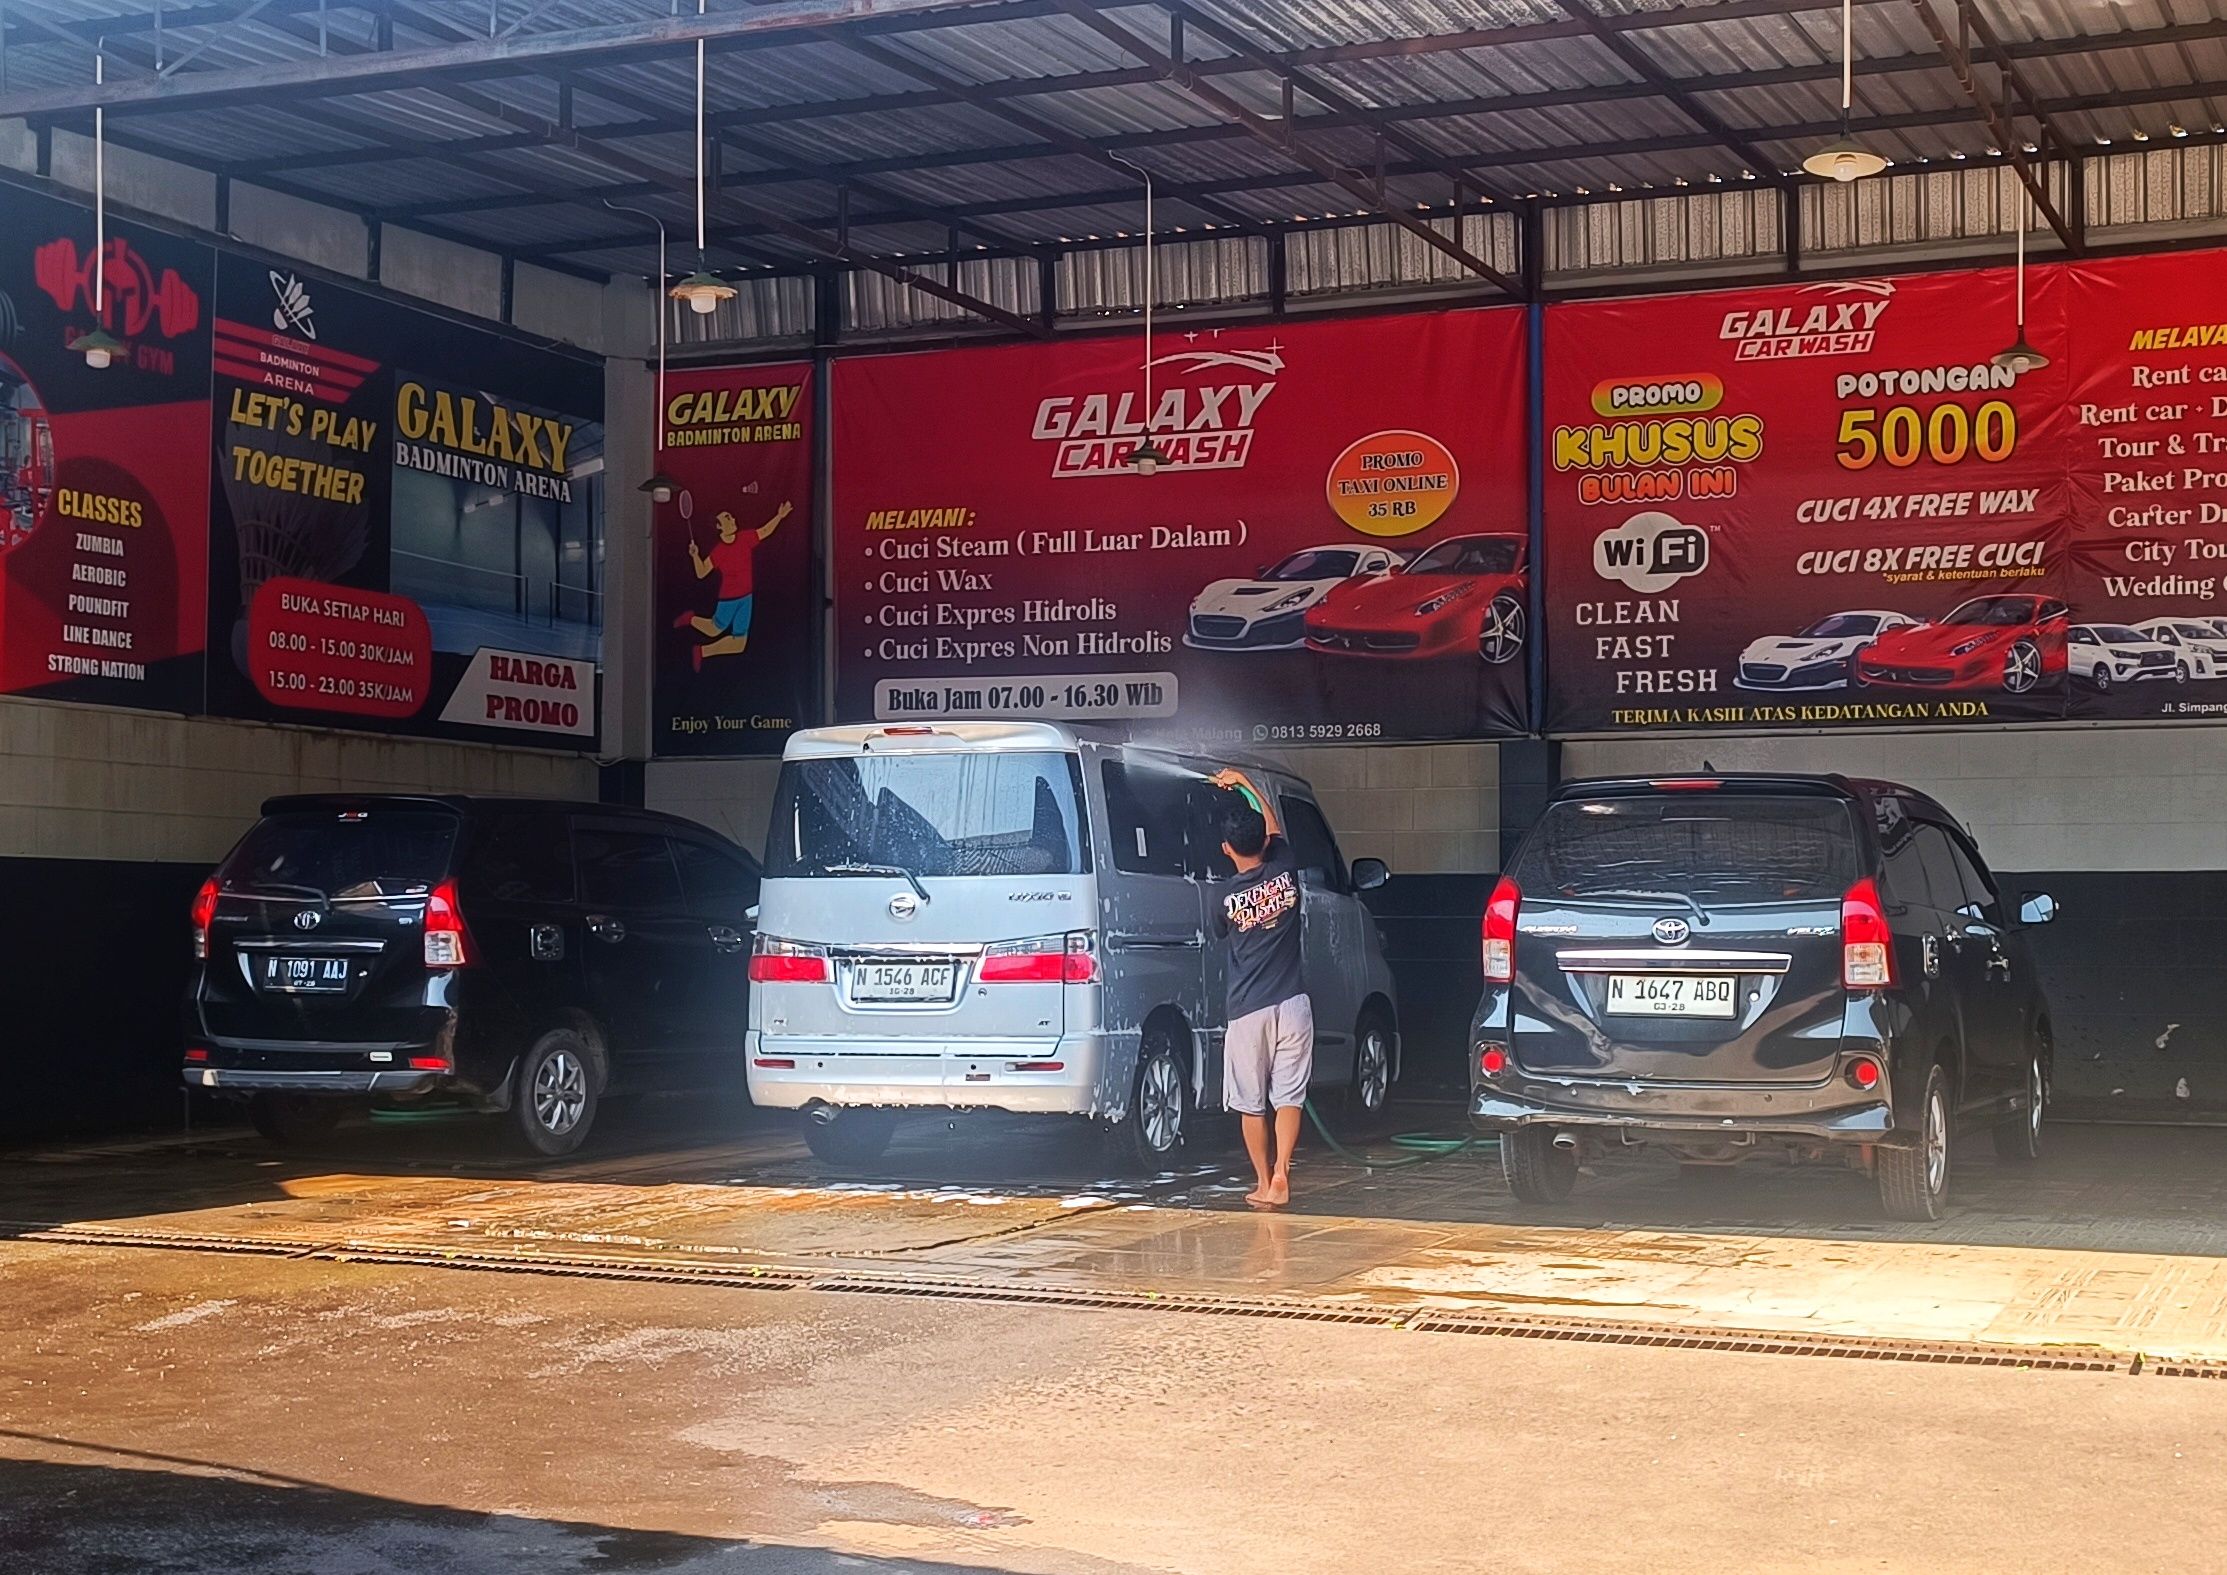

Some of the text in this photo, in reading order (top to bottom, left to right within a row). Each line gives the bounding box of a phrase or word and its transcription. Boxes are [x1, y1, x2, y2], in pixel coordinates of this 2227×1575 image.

[1718, 300, 1891, 339] GALAXY
[1740, 333, 1871, 359] CAR WASH
[2128, 324, 2227, 351] MELAYA
[260, 351, 320, 377] BADMINTON
[2131, 364, 2192, 388] Rent
[263, 372, 315, 396] ARENA
[1836, 364, 2017, 399] POTONGAN
[667, 385, 801, 425] GALAXY
[1611, 381, 1703, 409] PROMO
[230, 387, 378, 453] LET'S PLAY
[1031, 381, 1277, 440] GALAXY
[2079, 402, 2139, 426] Rent
[2145, 403, 2189, 421] car
[396, 381, 573, 474] GALAXY
[667, 423, 801, 447] BADMINTON ARENA
[1836, 399, 2017, 470] 5000
[1554, 414, 1763, 471] KHUSUS
[2098, 432, 2227, 458] Tour & Tr
[1058, 440, 1138, 472] CAR
[1361, 452, 1424, 470] PROMO
[232, 446, 366, 505] TOGETHER
[395, 441, 572, 503] BADMINTON ARENA
[1338, 474, 1448, 496] TAXI ONLINE
[1580, 466, 1737, 504] BULAN INI
[2103, 468, 2227, 493] Paket Pro
[57, 488, 143, 529] CLASSES
[1368, 501, 1417, 517] 35 RB
[1796, 488, 2040, 523] CUCI 4X FREE WAX
[2107, 503, 2193, 528] Carter
[76, 532, 125, 557] ZUMBIA
[879, 537, 930, 560] Cuci
[936, 535, 1010, 558] Steam
[1031, 530, 1077, 555] Full
[1084, 529, 1143, 553] Luar
[1149, 524, 1232, 549] Dalam
[2125, 541, 2177, 566] City
[1796, 541, 2046, 575] CUCI 8X FREE CUCI
[72, 562, 127, 588] AEROBIC
[879, 569, 993, 593] Cuci Wax
[1926, 570, 1936, 580] &
[1937, 569, 1998, 581] ketentuan
[2000, 567, 2046, 578] berlaku
[2101, 574, 2216, 600] Wedding
[68, 593, 130, 619] POUNDFIT
[281, 593, 405, 628] BUKA SETIAP HARI
[879, 597, 1117, 630] Cuci Expres Hidrolis
[1576, 599, 1680, 625] CLEAN
[63, 624, 133, 650] LINE DANCE
[268, 630, 308, 652] 08.00
[320, 637, 357, 659] 15.00
[358, 643, 415, 667] 30K/JAM
[878, 630, 1172, 664] Cuci Expres Non Hidrolis
[1595, 635, 1675, 660] FAST
[48, 653, 146, 682] STRONG NATION
[489, 655, 577, 691] HARGA
[268, 669, 307, 690] 15.00
[318, 676, 356, 697] 23.00
[358, 682, 414, 703] 35K/JAM
[1616, 669, 1718, 694] FRESH
[887, 688, 939, 711] Buka
[942, 687, 983, 713] Jam
[988, 685, 1045, 709] 07.00
[1063, 683, 1120, 708] 16.30
[1125, 682, 1164, 706] Wib
[2178, 702, 2227, 715] Simpang
[485, 694, 579, 728] PROMO
[671, 714, 793, 734] Enjoy Your Game
[1611, 702, 1990, 725] TERIMA KASIH ATAS KEDATANGAN ANDA
[1271, 725, 1305, 739] 0813
[1308, 724, 1343, 738] 5929
[1346, 723, 1381, 737] 2668
[1224, 873, 1292, 919] DEKENGAN
[267, 959, 349, 979] N 1091 AAJ
[856, 967, 951, 986] N 1546 ACF
[1611, 978, 1730, 1001] N 1647 ABQ
